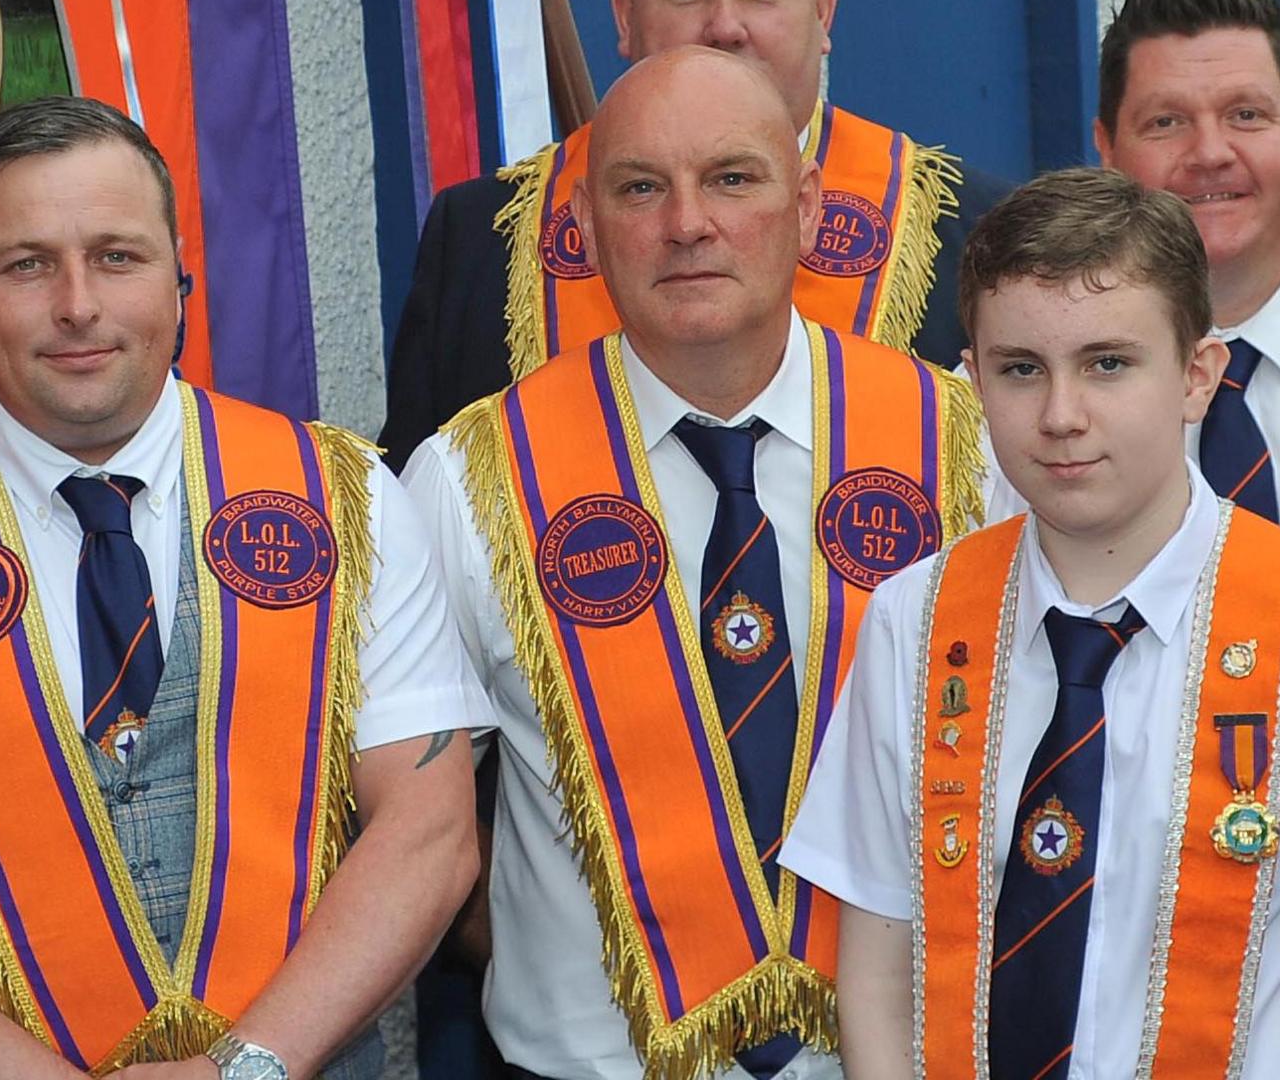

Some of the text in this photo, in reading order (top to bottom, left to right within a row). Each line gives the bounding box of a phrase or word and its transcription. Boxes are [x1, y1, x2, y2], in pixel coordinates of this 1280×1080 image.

[821, 232, 852, 255] 512
[842, 256, 876, 272] STAR
[837, 476, 928, 515] BRAIDWATER
[221, 496, 320, 529] BRAIDWATER
[852, 502, 908, 535] L.O.L.
[241, 521, 300, 548] L.O.L.
[544, 502, 656, 573] NORTH BALLYMENA
[863, 533, 896, 561] 512
[254, 549, 290, 575] 512
[563, 540, 640, 579] TREASURER
[828, 542, 883, 584] PURPLE
[216, 559, 325, 599] PURPLE STAR
[562, 578, 654, 617] HARRYVILLE
